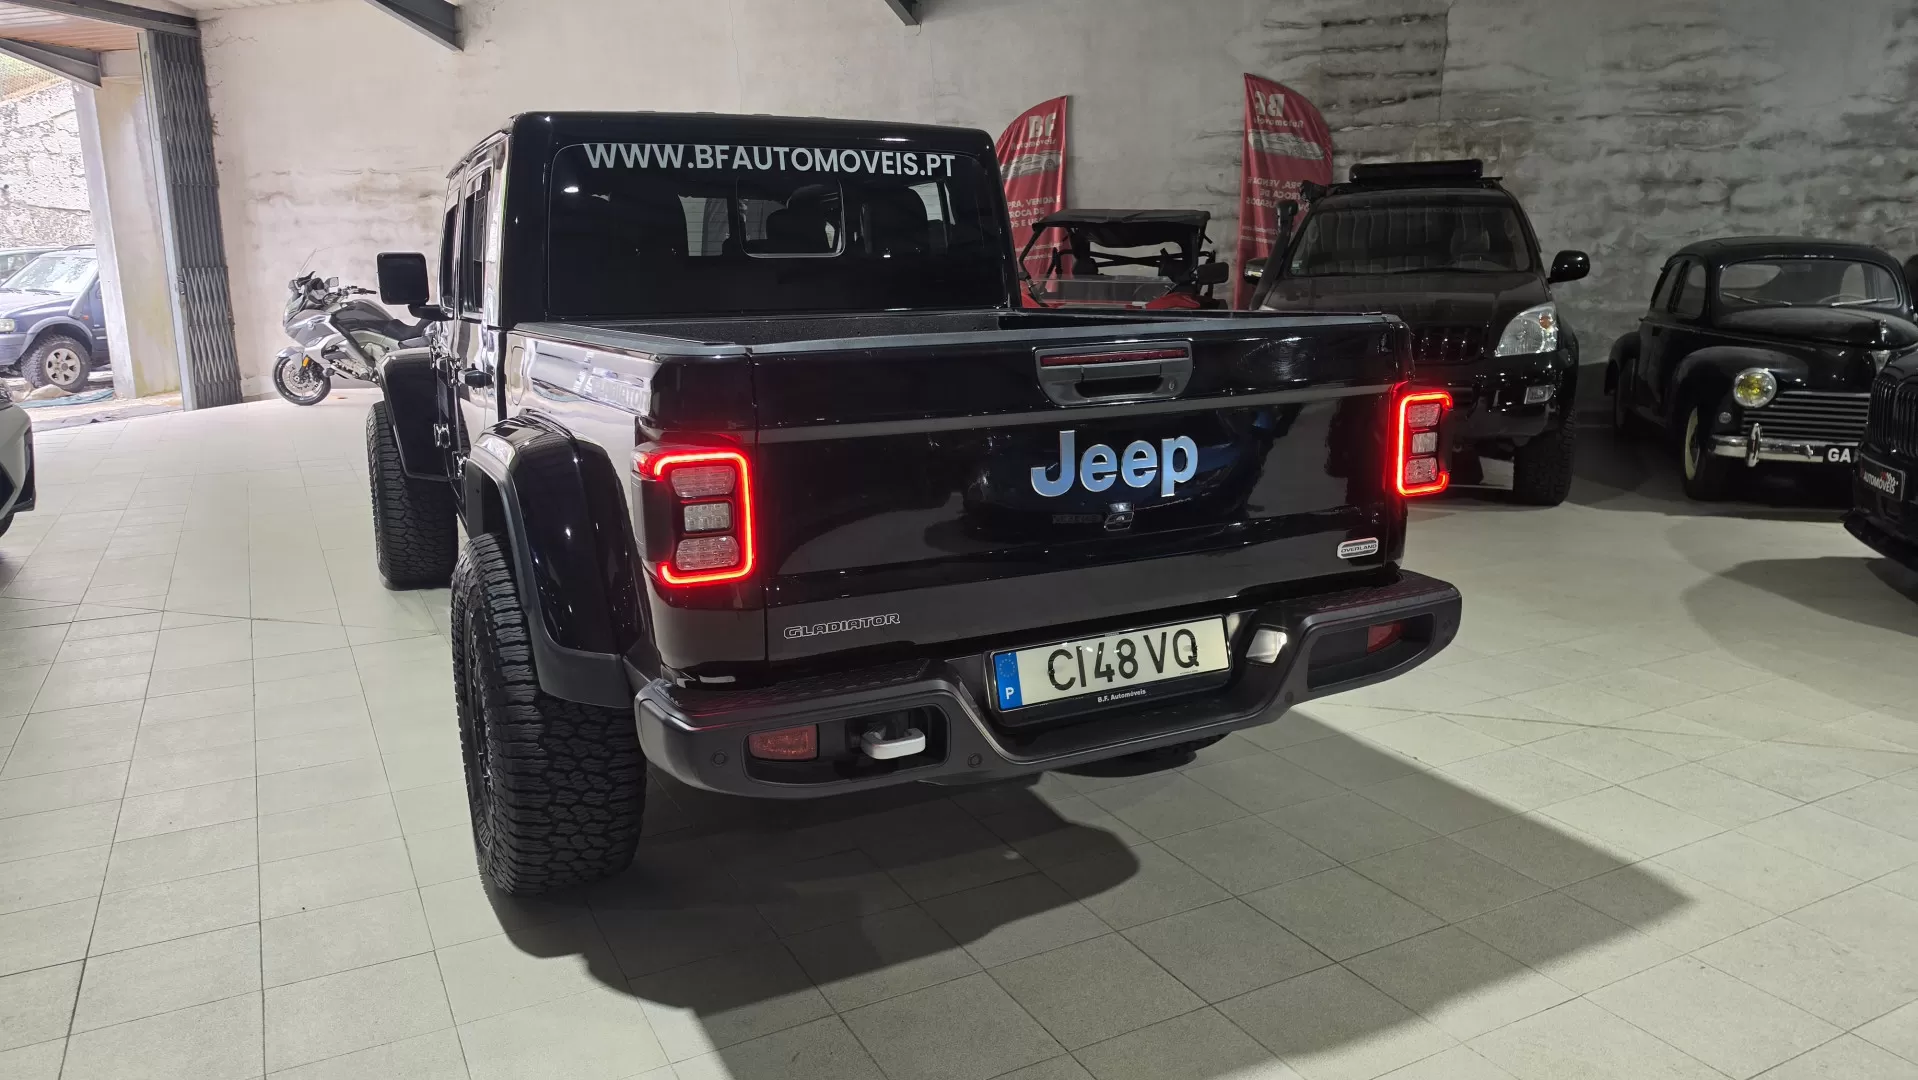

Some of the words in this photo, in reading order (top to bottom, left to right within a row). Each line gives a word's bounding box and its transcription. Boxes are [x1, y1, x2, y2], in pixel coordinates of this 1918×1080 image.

[583, 143, 956, 177] WWW.BFAUTOMOVEIS.PT
[1007, 200, 1024, 209] PRA,
[1030, 430, 1199, 498] Jeep
[1340, 543, 1378, 554] OVERLAND
[784, 613, 901, 639] GLADIATOR
[1005, 686, 1015, 700] P
[1097, 695, 1110, 703] B.F.
